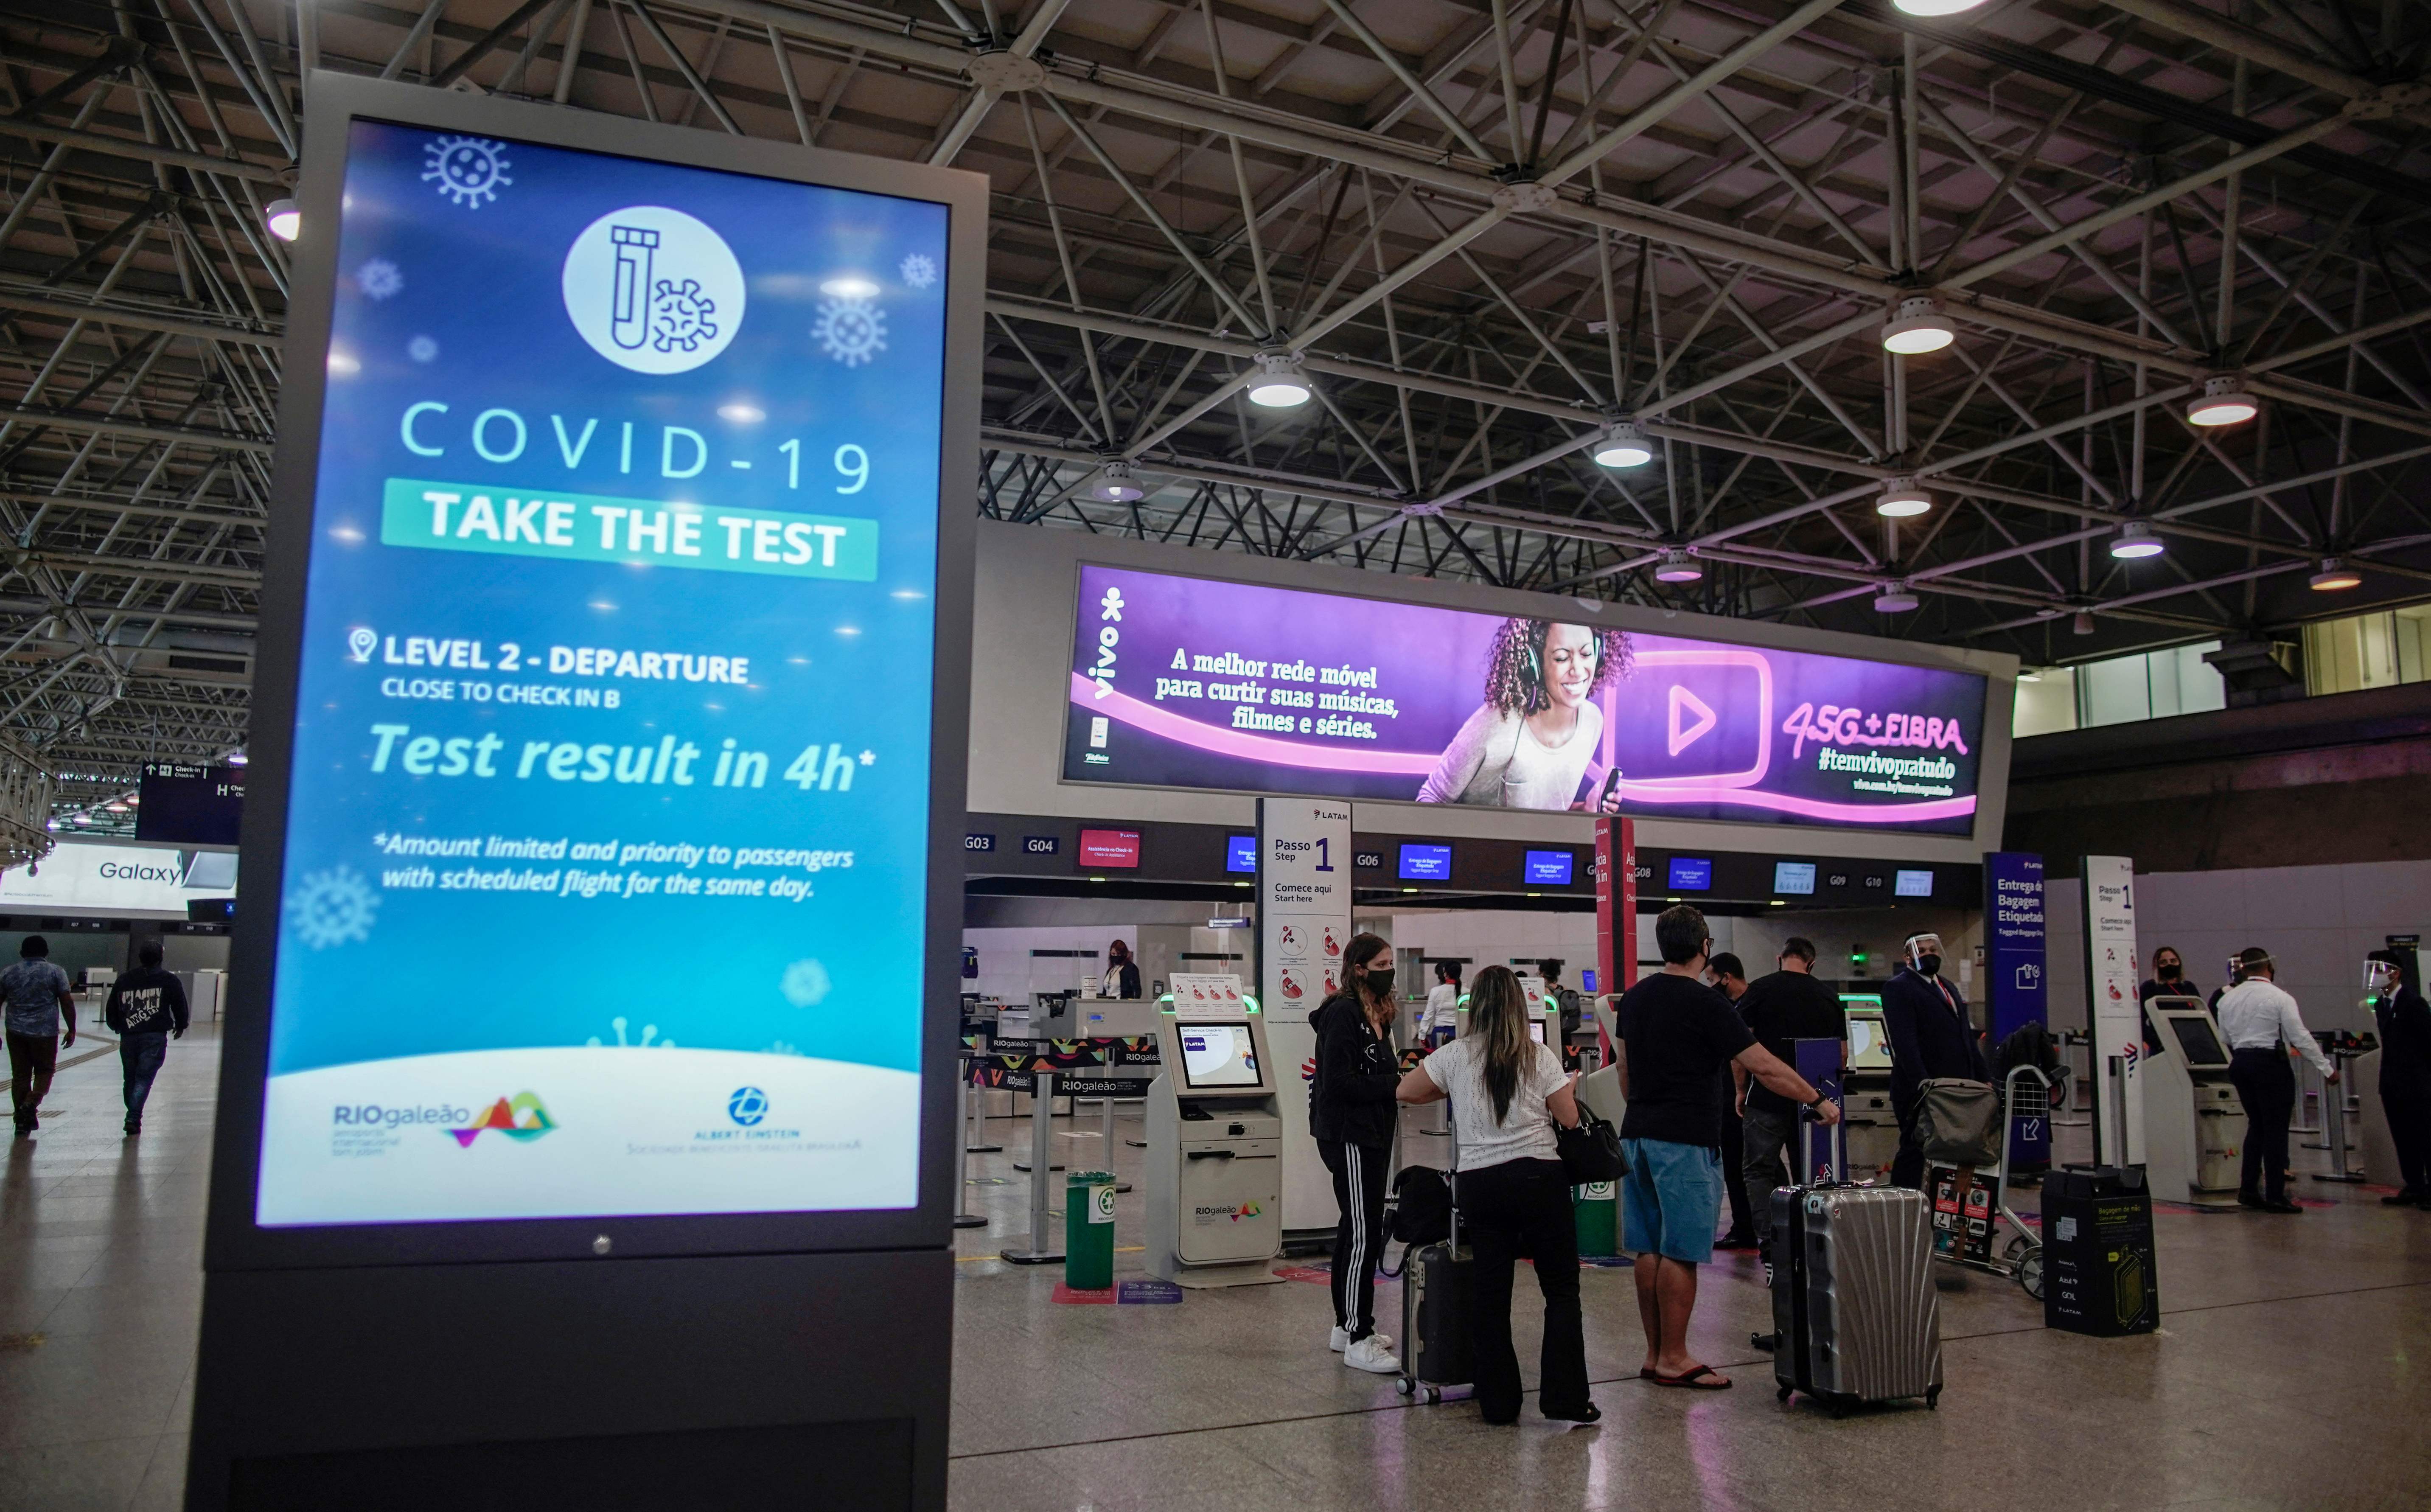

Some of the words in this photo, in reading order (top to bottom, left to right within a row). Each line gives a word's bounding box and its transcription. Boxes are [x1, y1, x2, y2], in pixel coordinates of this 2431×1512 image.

[400, 401, 870, 495] COVID-19
[423, 491, 576, 547] TAKE
[591, 505, 702, 557] THE
[718, 516, 846, 567] TEST
[384, 637, 490, 670] LEVEL
[496, 643, 520, 671] 2
[549, 646, 749, 684] DEPARTURE
[1088, 626, 1119, 699] vivo
[1170, 648, 1187, 670] A
[1193, 652, 1266, 679] melhor
[1271, 658, 1315, 682] rede
[1320, 664, 1377, 689] móvel
[381, 678, 454, 701] CLOSE
[459, 682, 490, 701] TO
[495, 683, 572, 707] CHECK
[575, 688, 600, 707] IN
[604, 689, 620, 709] B
[1155, 676, 1202, 700] para
[1208, 680, 1267, 704] curtir
[1270, 690, 1313, 709] suas
[1318, 691, 1399, 718] músicas,
[1231, 706, 1294, 732] filmes
[1299, 718, 1312, 733] e
[1315, 713, 1377, 740] séries.
[369, 723, 504, 777] Test
[516, 735, 700, 785] result
[712, 738, 769, 789] in
[1818, 746, 1956, 780] #temvivopratudo
[217, 784, 228, 797] H
[1322, 811, 1348, 821] LATAM
[965, 836, 990, 850] G03
[1028, 839, 1053, 852] G04
[485, 835, 566, 861] limited
[569, 839, 616, 863] and
[620, 840, 706, 867] priority
[707, 846, 731, 866] to
[734, 848, 854, 872] passengers
[1275, 852, 1295, 862] Step
[1276, 839, 1310, 851] Passo
[1316, 837, 1334, 872] 1
[1357, 854, 1379, 866] G06
[100, 862, 181, 886] Galaxy
[1635, 867, 1651, 878] G08
[382, 867, 435, 889] with
[440, 867, 558, 894] scheduled
[560, 868, 624, 897] flight
[625, 870, 662, 899] for
[665, 872, 701, 895] the
[704, 878, 765, 897] same
[769, 875, 814, 901] day.
[1830, 875, 1847, 886] G09
[1865, 876, 1882, 887] G10
[1998, 878, 2035, 895] Entrega
[1275, 883, 1312, 892] Comece
[1314, 884, 1331, 895] aqui
[1998, 894, 2040, 910] Bagagem
[2099, 885, 2121, 895] Passo
[2123, 885, 2132, 909] 1
[1998, 928, 2019, 937] Tagged
[994, 1040, 1029, 1048] RIOgaleão
[1007, 1075, 1028, 1087] RIOgaleão
[1062, 1081, 1116, 1092] RIOgaleão
[334, 1104, 470, 1129] RIOgaleão
[694, 1130, 740, 1140] ALBERT
[746, 1129, 800, 1140] EINSTEIN
[1196, 1206, 1237, 1216] RIOgaleão
[2059, 1276, 2072, 1284] Azul
[2061, 1291, 2076, 1301] GOL
